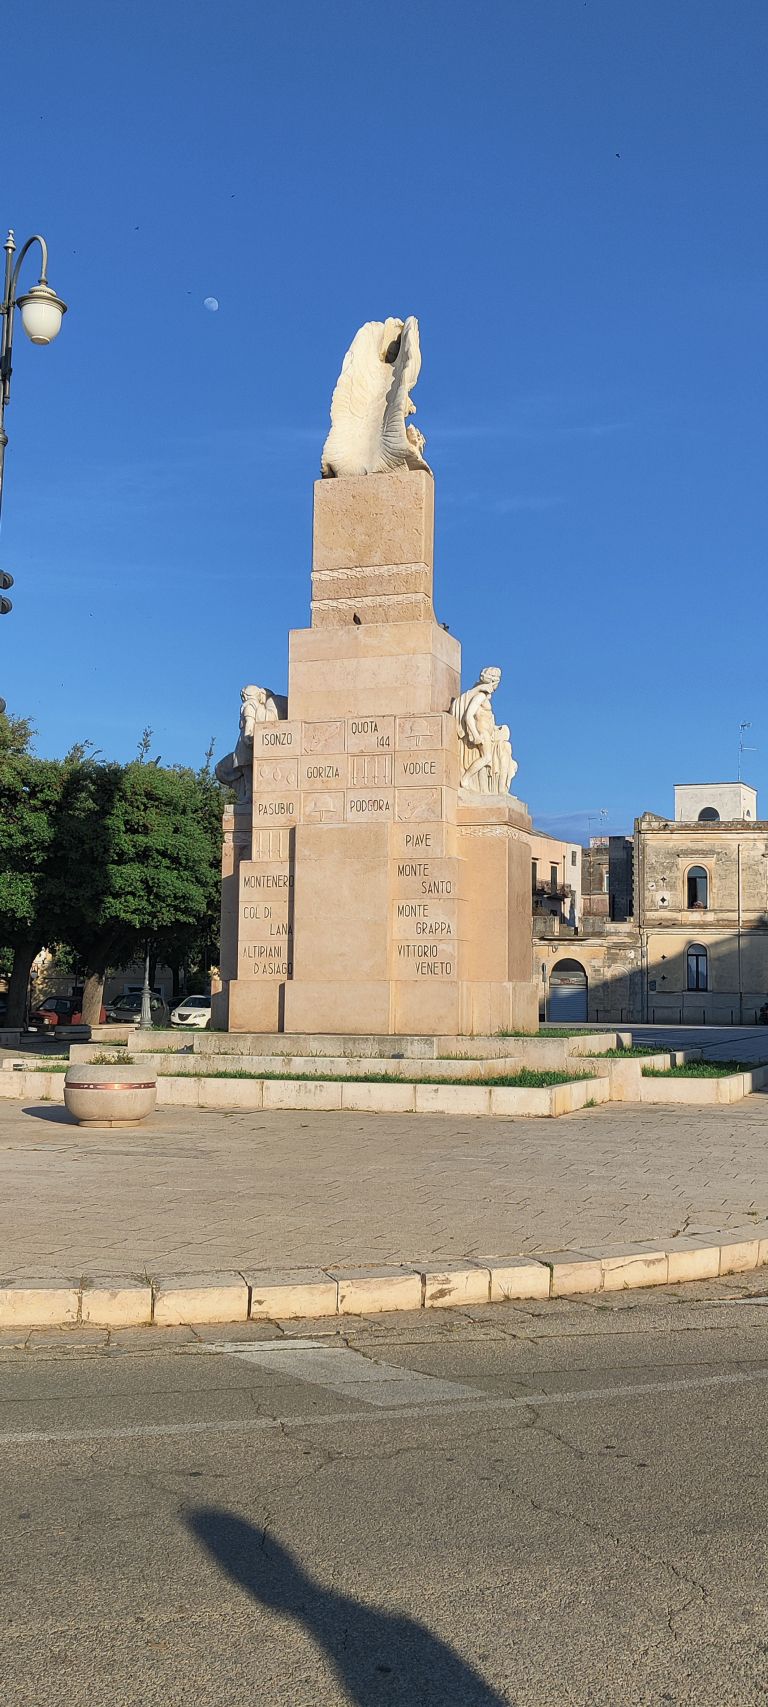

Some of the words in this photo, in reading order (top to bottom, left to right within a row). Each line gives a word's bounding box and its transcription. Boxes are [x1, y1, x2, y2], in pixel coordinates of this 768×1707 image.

[351, 721, 379, 735] QUOTA
[262, 733, 292, 746] ISONZO
[376, 736, 391, 748] 144
[306, 766, 340, 779] GORIZIA
[403, 762, 436, 775] VODICE
[258, 802, 294, 816] PASUBIO
[350, 800, 390, 812] PODGORA
[405, 834, 432, 847] PIAVE
[397, 864, 430, 877] MONTE
[421, 881, 452, 894] SANTO
[243, 906, 261, 919] COL
[264, 906, 272, 919] DI
[397, 904, 429, 918] MONTE
[270, 923, 293, 936] LANA
[415, 922, 452, 935] GRAPPA
[243, 945, 282, 959] ALTIPIANI
[397, 944, 438, 958] VITTORIO
[253, 962, 293, 975] D'ASIAGO
[415, 961, 452, 975] VENETO
